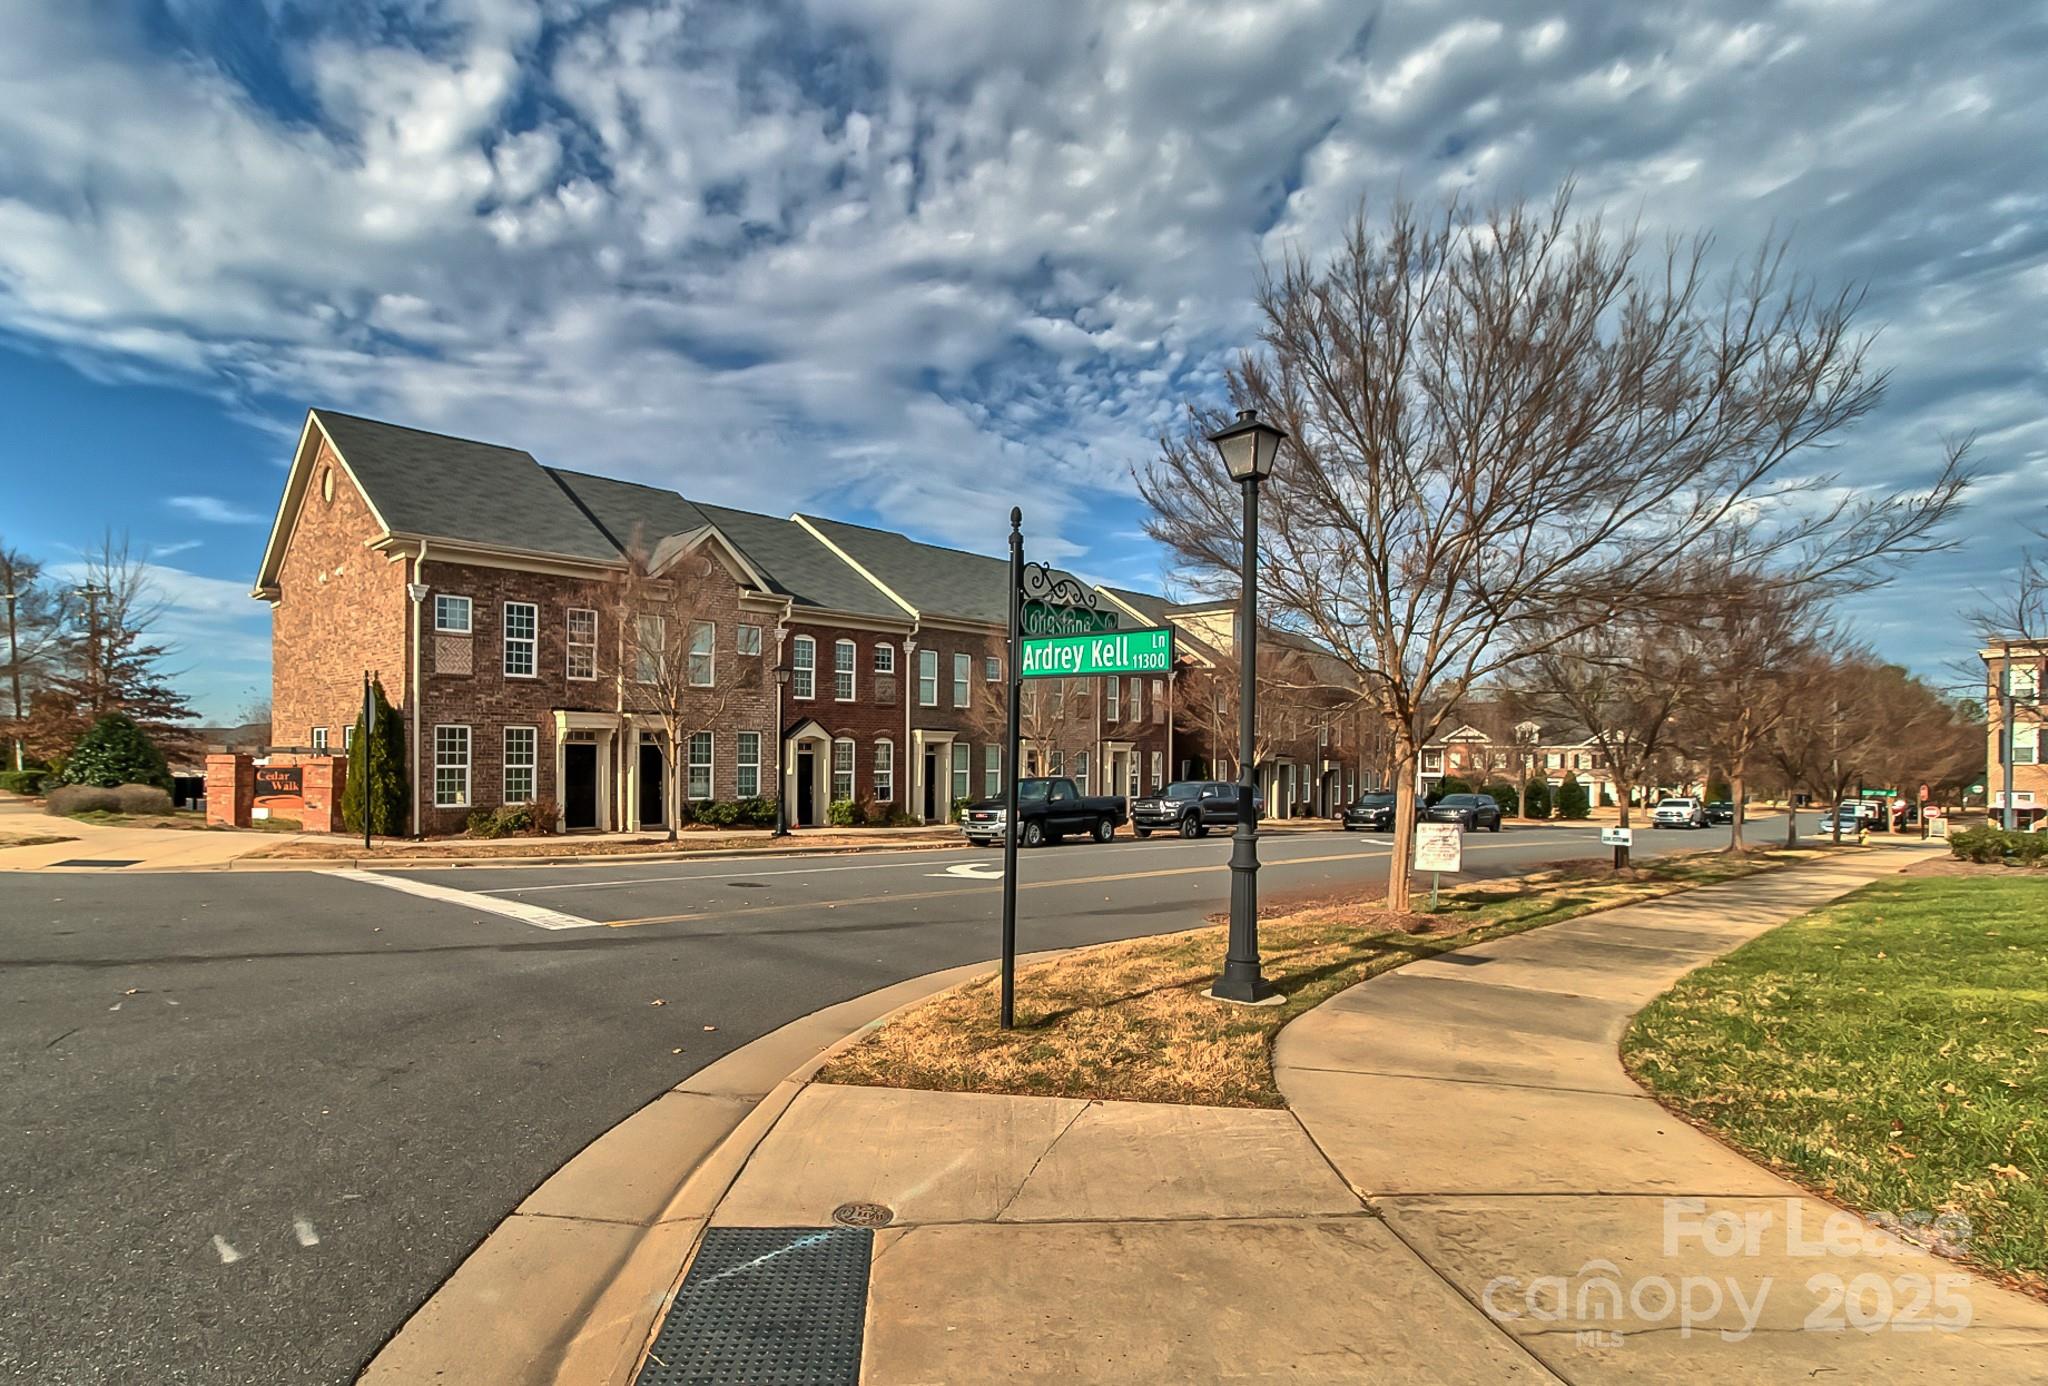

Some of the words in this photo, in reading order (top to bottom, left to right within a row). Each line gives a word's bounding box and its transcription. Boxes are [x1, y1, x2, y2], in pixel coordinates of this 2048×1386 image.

[1022, 640, 1085, 673] Ardrey
[1091, 636, 1129, 668] Kell
[1152, 633, 1166, 649] Ln
[1132, 652, 1166, 669] 11300
[256, 770, 290, 781] Cedar
[271, 780, 300, 791] Walk
